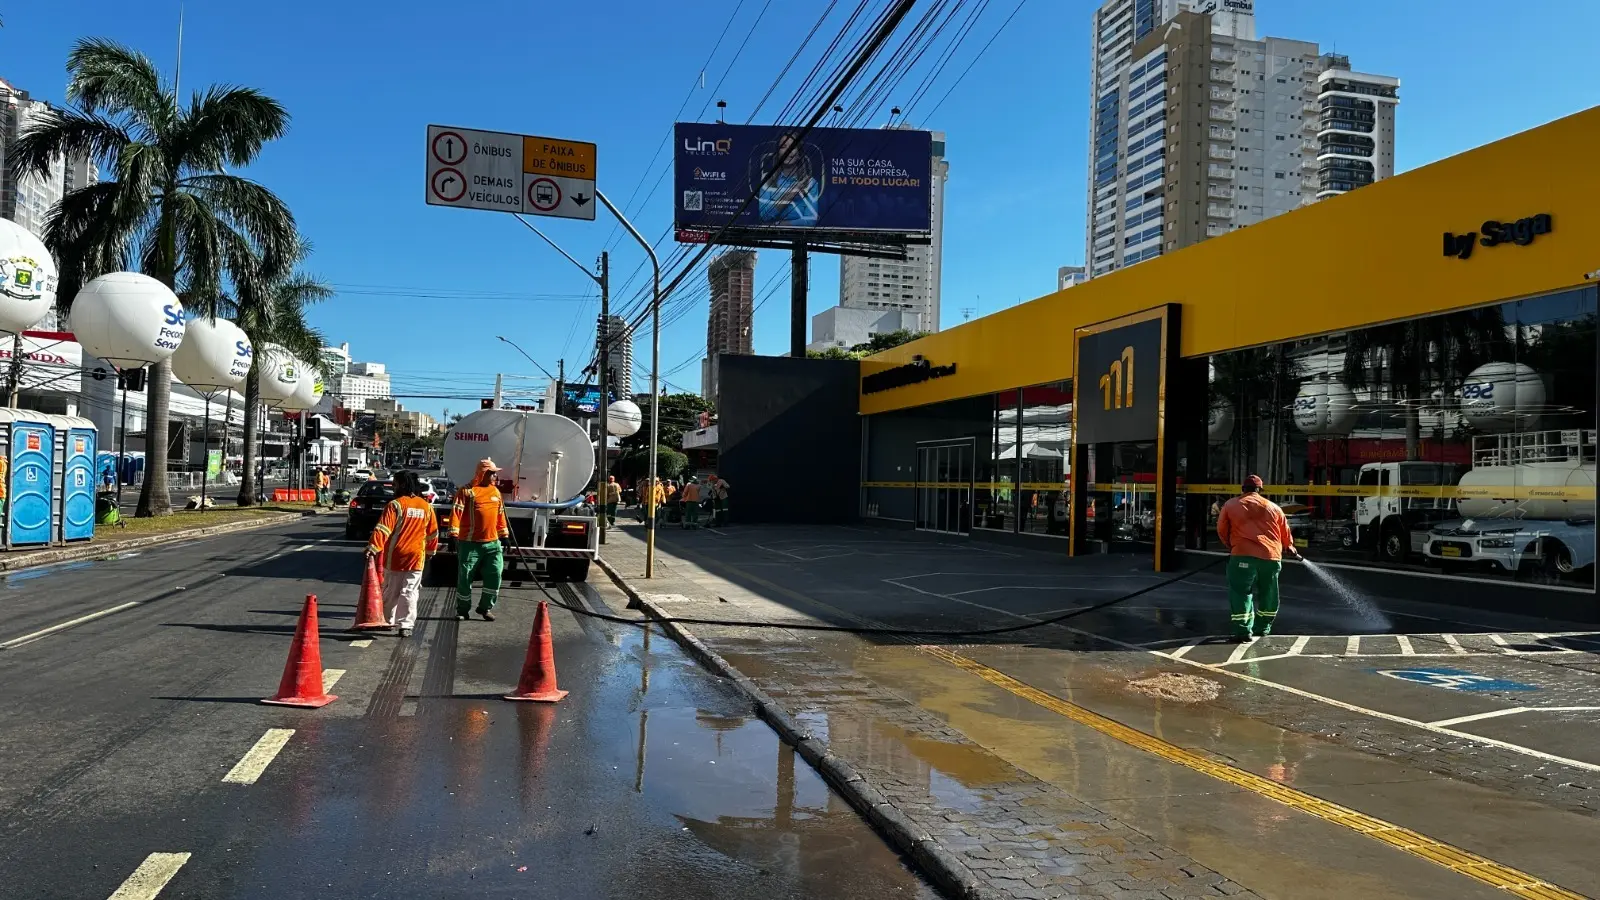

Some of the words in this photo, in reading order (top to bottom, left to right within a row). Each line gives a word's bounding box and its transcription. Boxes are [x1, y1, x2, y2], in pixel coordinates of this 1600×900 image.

[473, 142, 512, 157] ÔNIBUS
[543, 144, 574, 157] FAIXA
[533, 159, 545, 169] DE
[549, 160, 586, 173] ÔNIBUS
[832, 158, 845, 167] NA
[847, 158, 865, 167] SUA
[867, 159, 895, 169] CASA,
[832, 167, 845, 175] NA
[847, 167, 865, 176] SUA
[867, 168, 910, 178] EMPRESA,
[474, 175, 513, 188] DEMAIS
[832, 176, 847, 185] EM
[850, 177, 880, 187] TODO
[882, 178, 920, 187] LUGAR!
[469, 190, 520, 206] VEÍCULOS
[1443, 231, 1476, 260] by
[1480, 213, 1552, 247] Saga
[0, 350, 66, 364] HNDA
[455, 432, 489, 442] SEINFRA
